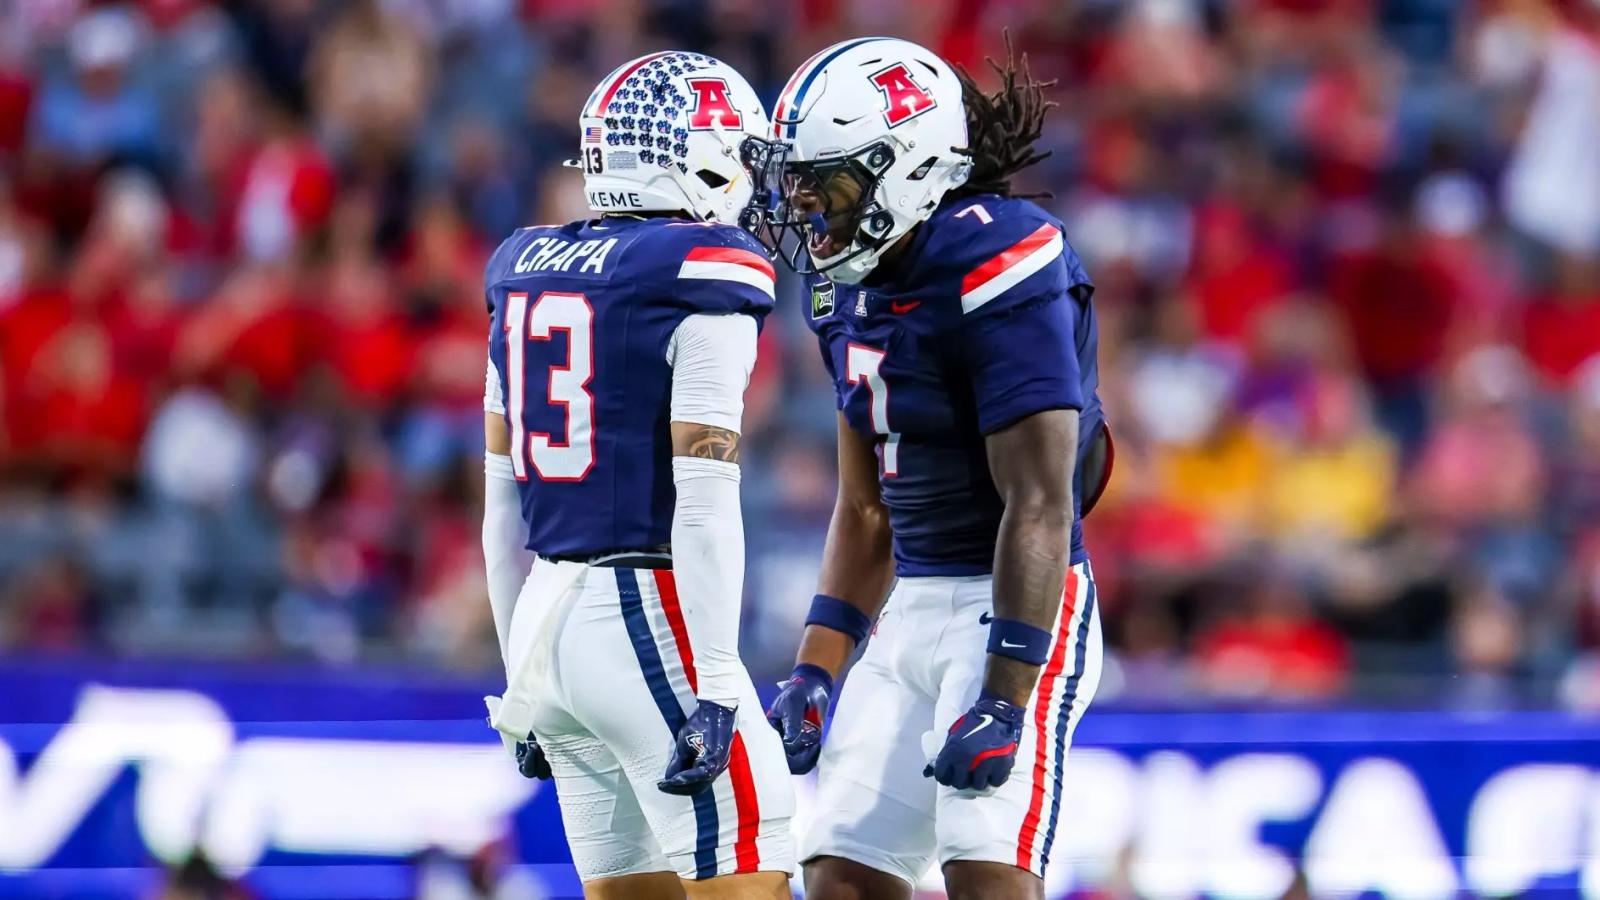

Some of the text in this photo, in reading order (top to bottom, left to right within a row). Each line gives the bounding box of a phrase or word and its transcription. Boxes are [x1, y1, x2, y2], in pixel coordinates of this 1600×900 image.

[685, 77, 744, 132] A
[867, 62, 937, 129] A
[585, 148, 603, 174] 13
[589, 192, 643, 207] KEME
[953, 204, 994, 225] 7
[514, 237, 618, 274] CHAPA
[504, 291, 597, 482] 13
[846, 343, 902, 477] 7
